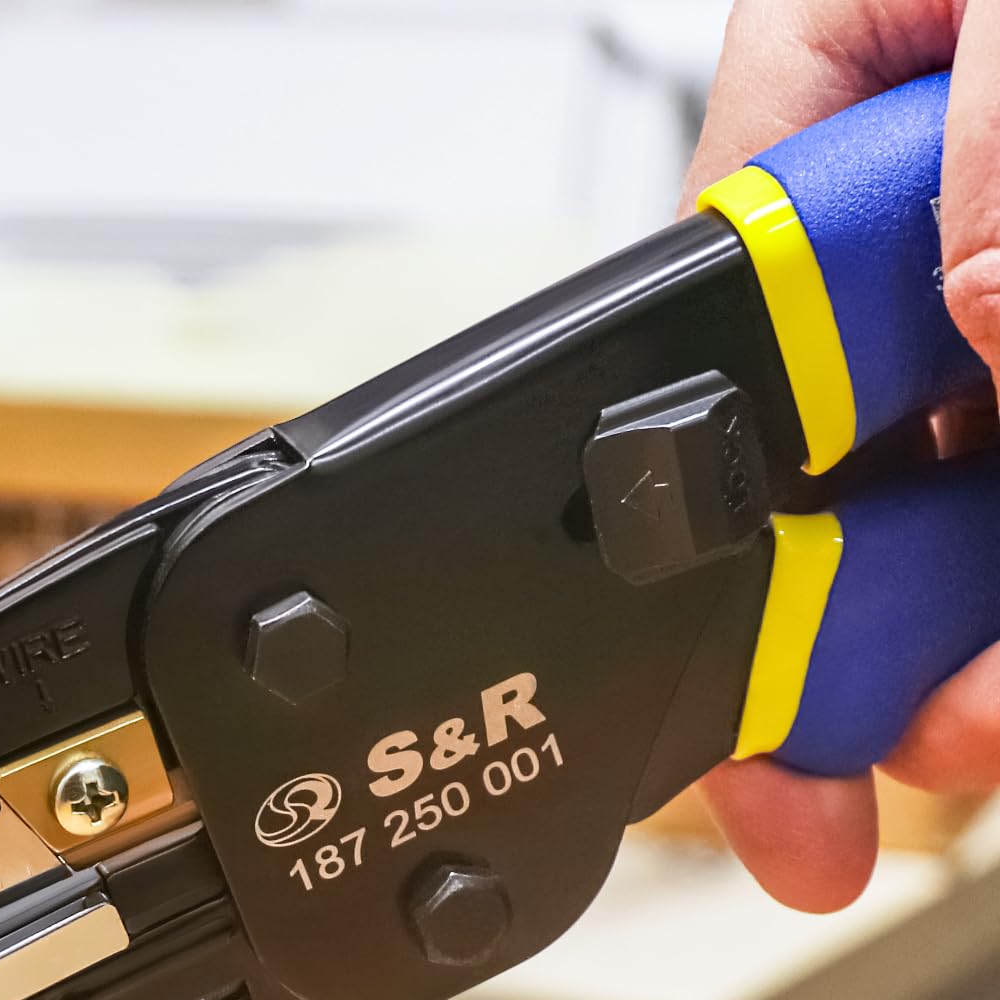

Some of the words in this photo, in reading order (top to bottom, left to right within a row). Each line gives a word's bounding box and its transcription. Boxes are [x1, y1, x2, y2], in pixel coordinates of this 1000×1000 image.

[367, 672, 547, 798] S&R
[289, 826, 367, 891] 187
[383, 781, 471, 848] 250
[482, 732, 565, 796] 001
